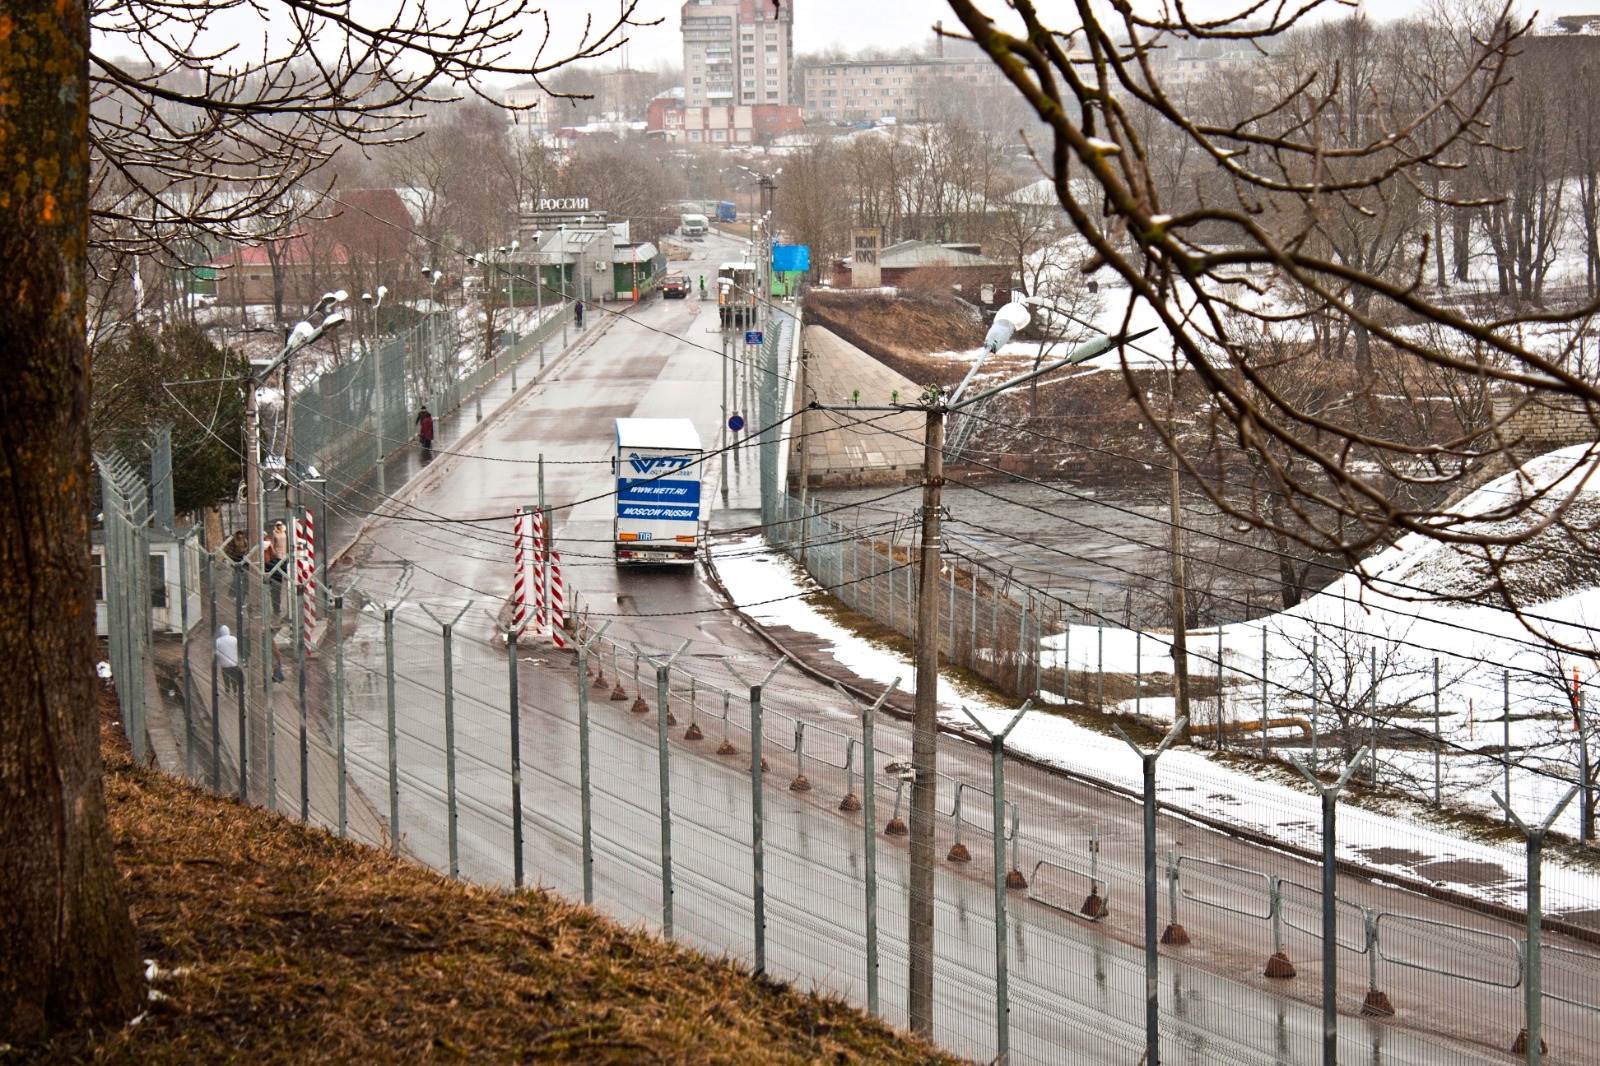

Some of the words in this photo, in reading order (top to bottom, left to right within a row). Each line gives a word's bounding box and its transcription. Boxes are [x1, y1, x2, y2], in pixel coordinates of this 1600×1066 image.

[540, 198, 589, 210] РОССИЯ
[629, 452, 692, 473] WETT
[631, 487, 687, 495] WWW.WETT.RU
[623, 508, 663, 516] MOSCOW
[662, 509, 693, 517] RUSSIA
[640, 532, 652, 541] TIR
